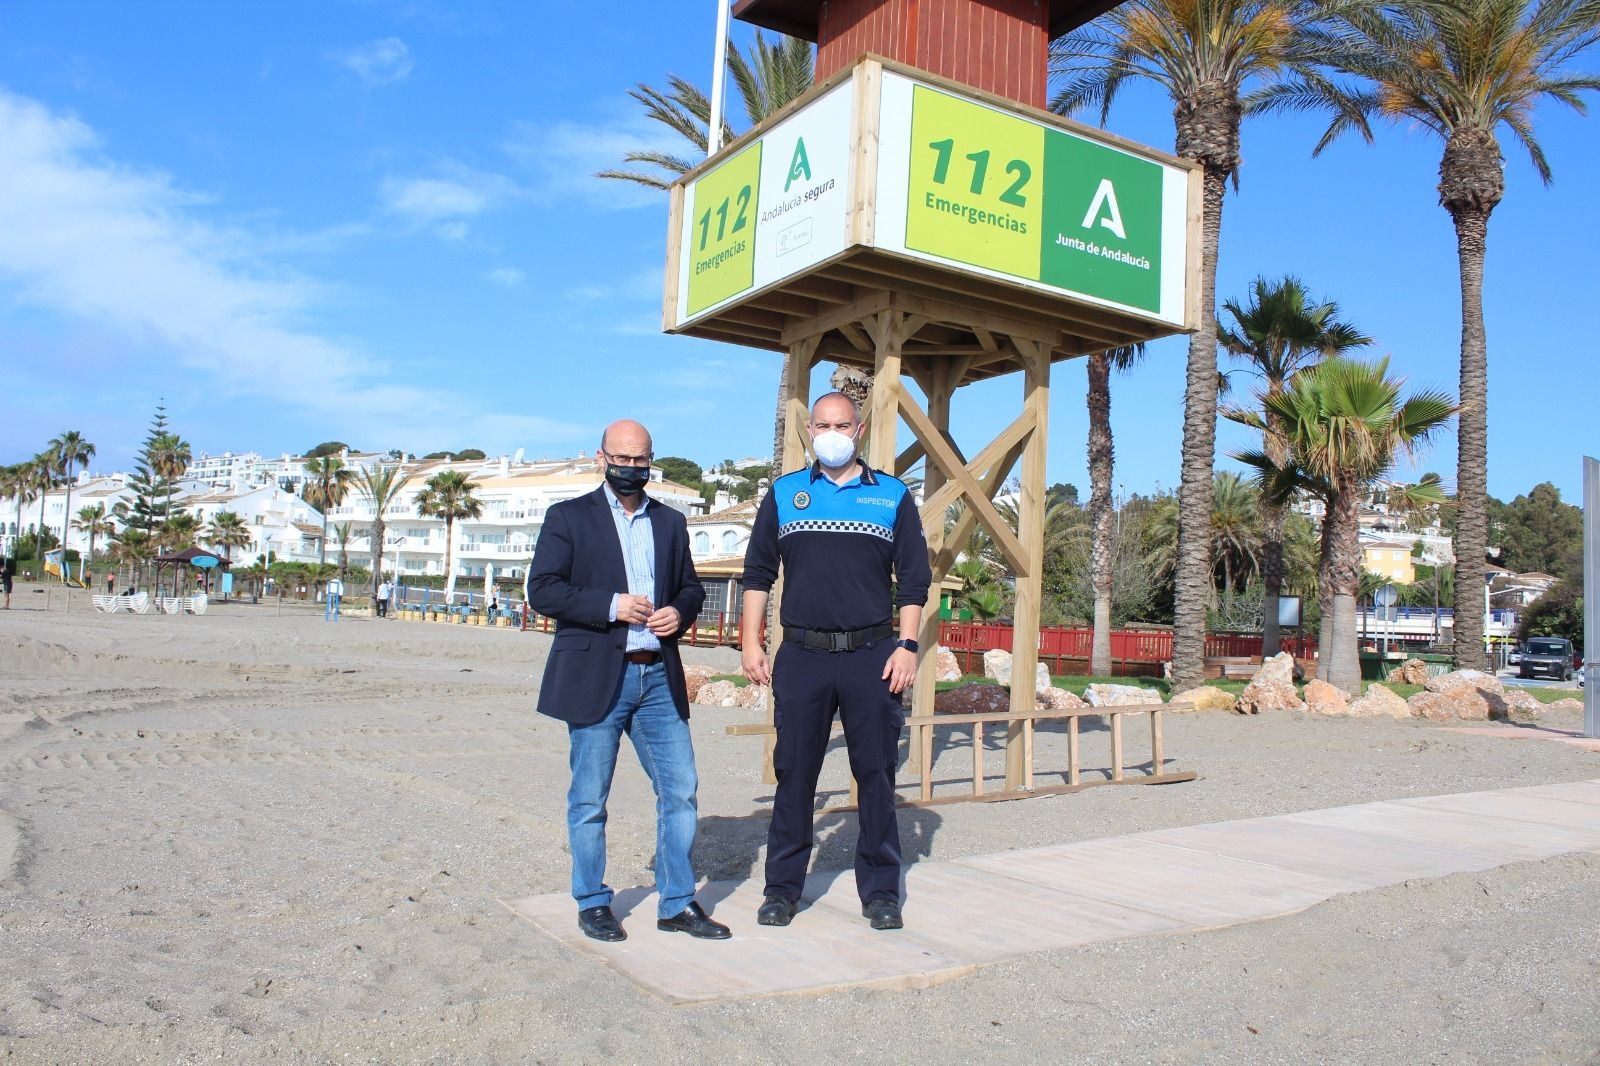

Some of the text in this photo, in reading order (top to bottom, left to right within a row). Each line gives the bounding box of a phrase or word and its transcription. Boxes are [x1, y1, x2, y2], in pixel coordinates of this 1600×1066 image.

[804, 178, 835, 202] segura
[928, 138, 1032, 208] 112
[699, 184, 751, 251] 112
[925, 191, 1027, 234] Emergencias
[695, 240, 746, 276] Emergencias
[1055, 233, 1150, 270] Junta de Andalucía
[856, 496, 896, 509] INSPECTOR
